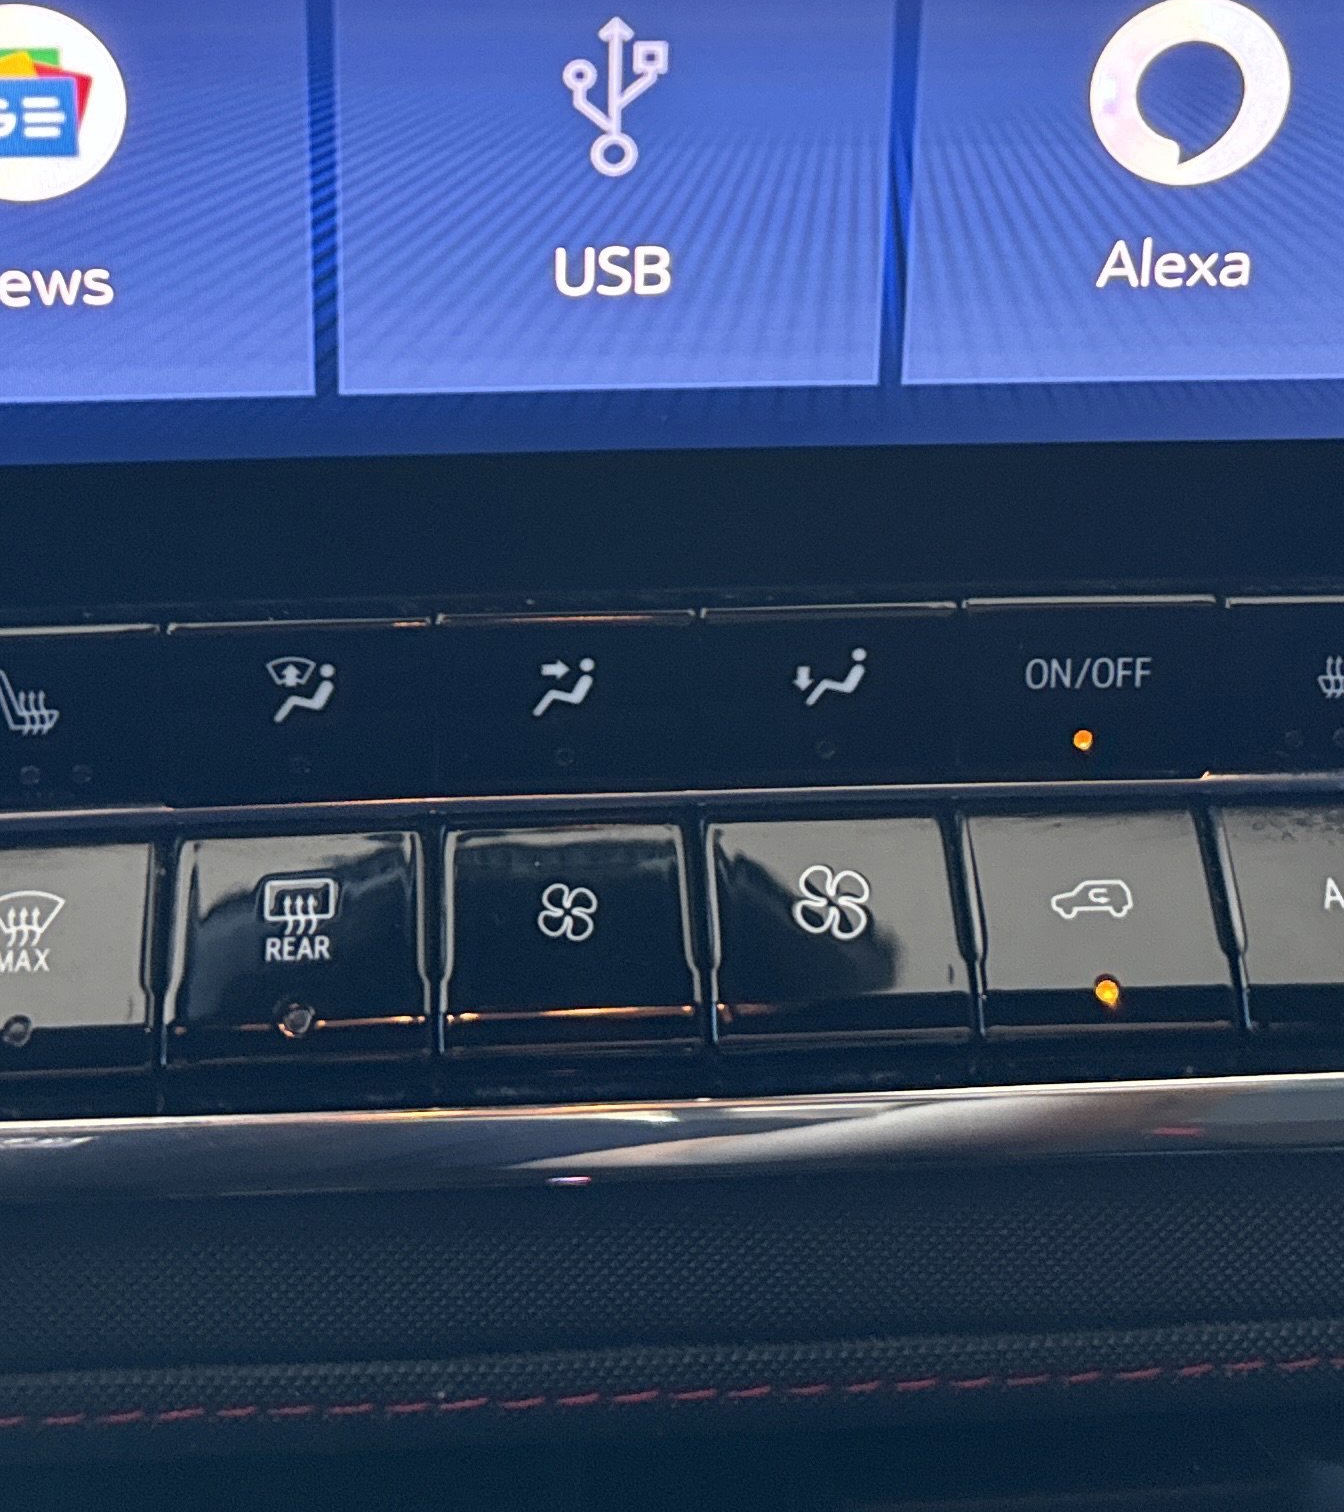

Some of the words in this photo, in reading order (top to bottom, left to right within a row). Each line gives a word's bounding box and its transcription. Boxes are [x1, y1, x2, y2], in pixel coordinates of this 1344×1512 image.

[555, 245, 672, 298] USB
[1095, 236, 1251, 289] Alexa
[1025, 657, 1152, 690] ON/OFF
[265, 935, 330, 962] REAR
